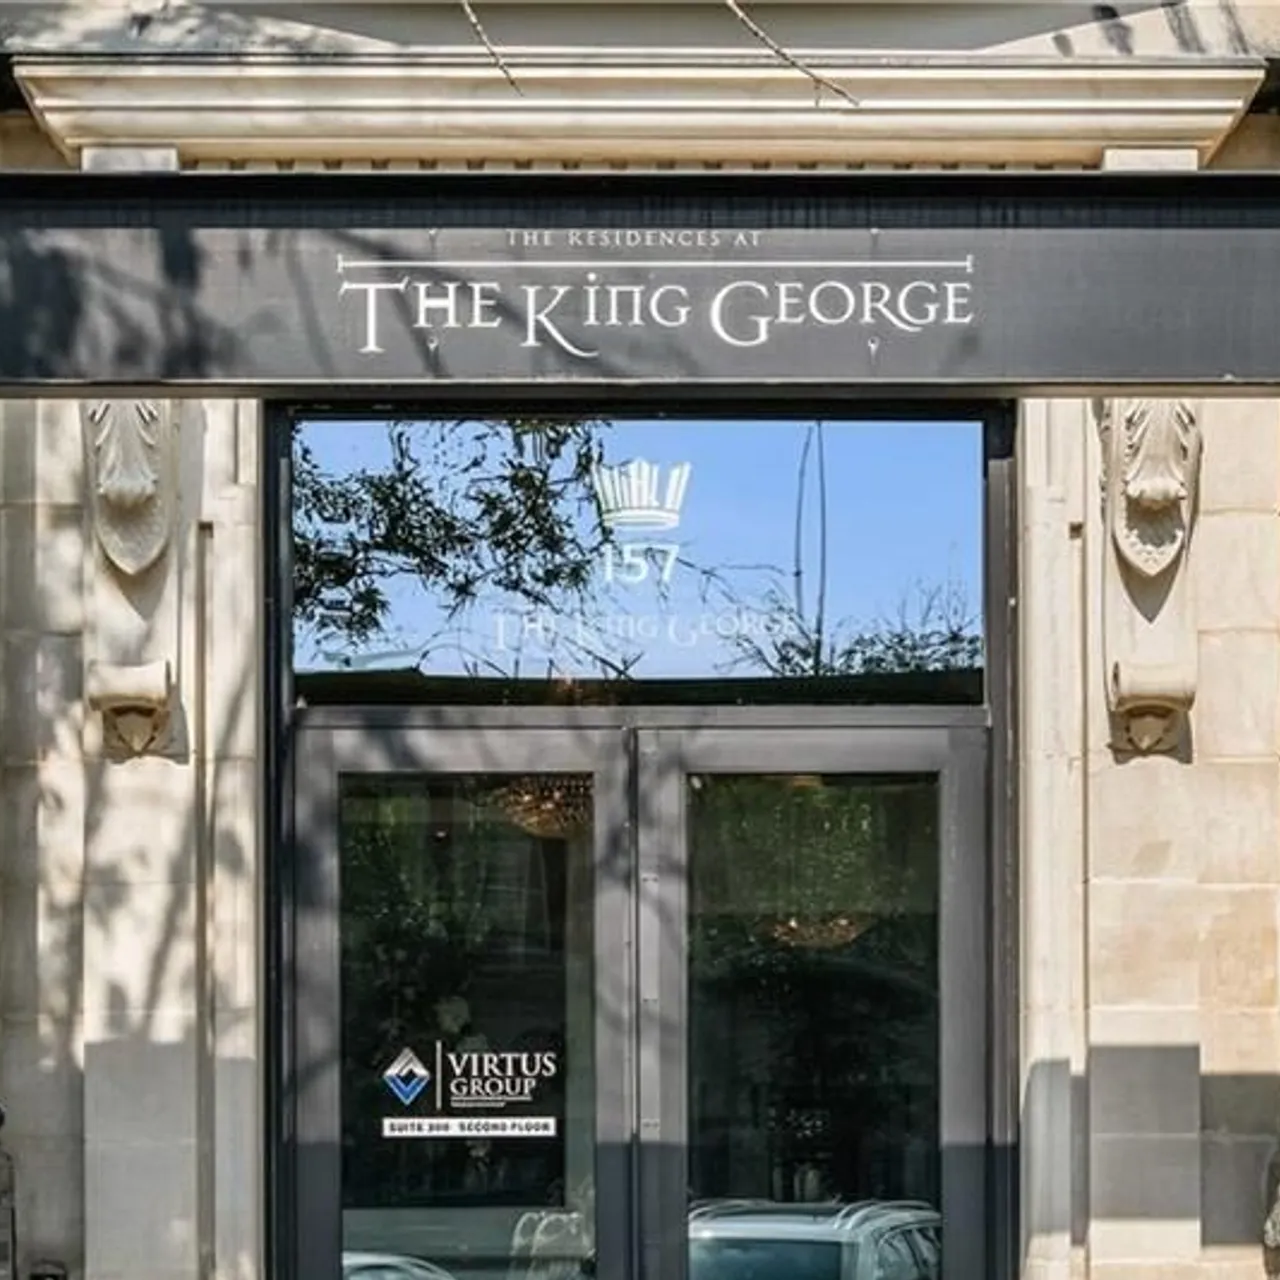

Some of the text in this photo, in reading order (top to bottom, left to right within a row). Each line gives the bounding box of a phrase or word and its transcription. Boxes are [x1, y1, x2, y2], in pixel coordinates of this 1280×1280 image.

[506, 229, 762, 247] THE RESIDENCES AT
[600, 543, 680, 584] 157
[446, 1052, 558, 1077] VIRTUS
[449, 1077, 536, 1096] GROUP
[458, 1121, 507, 1132] SECOND
[510, 1121, 551, 1132] FLOOR
